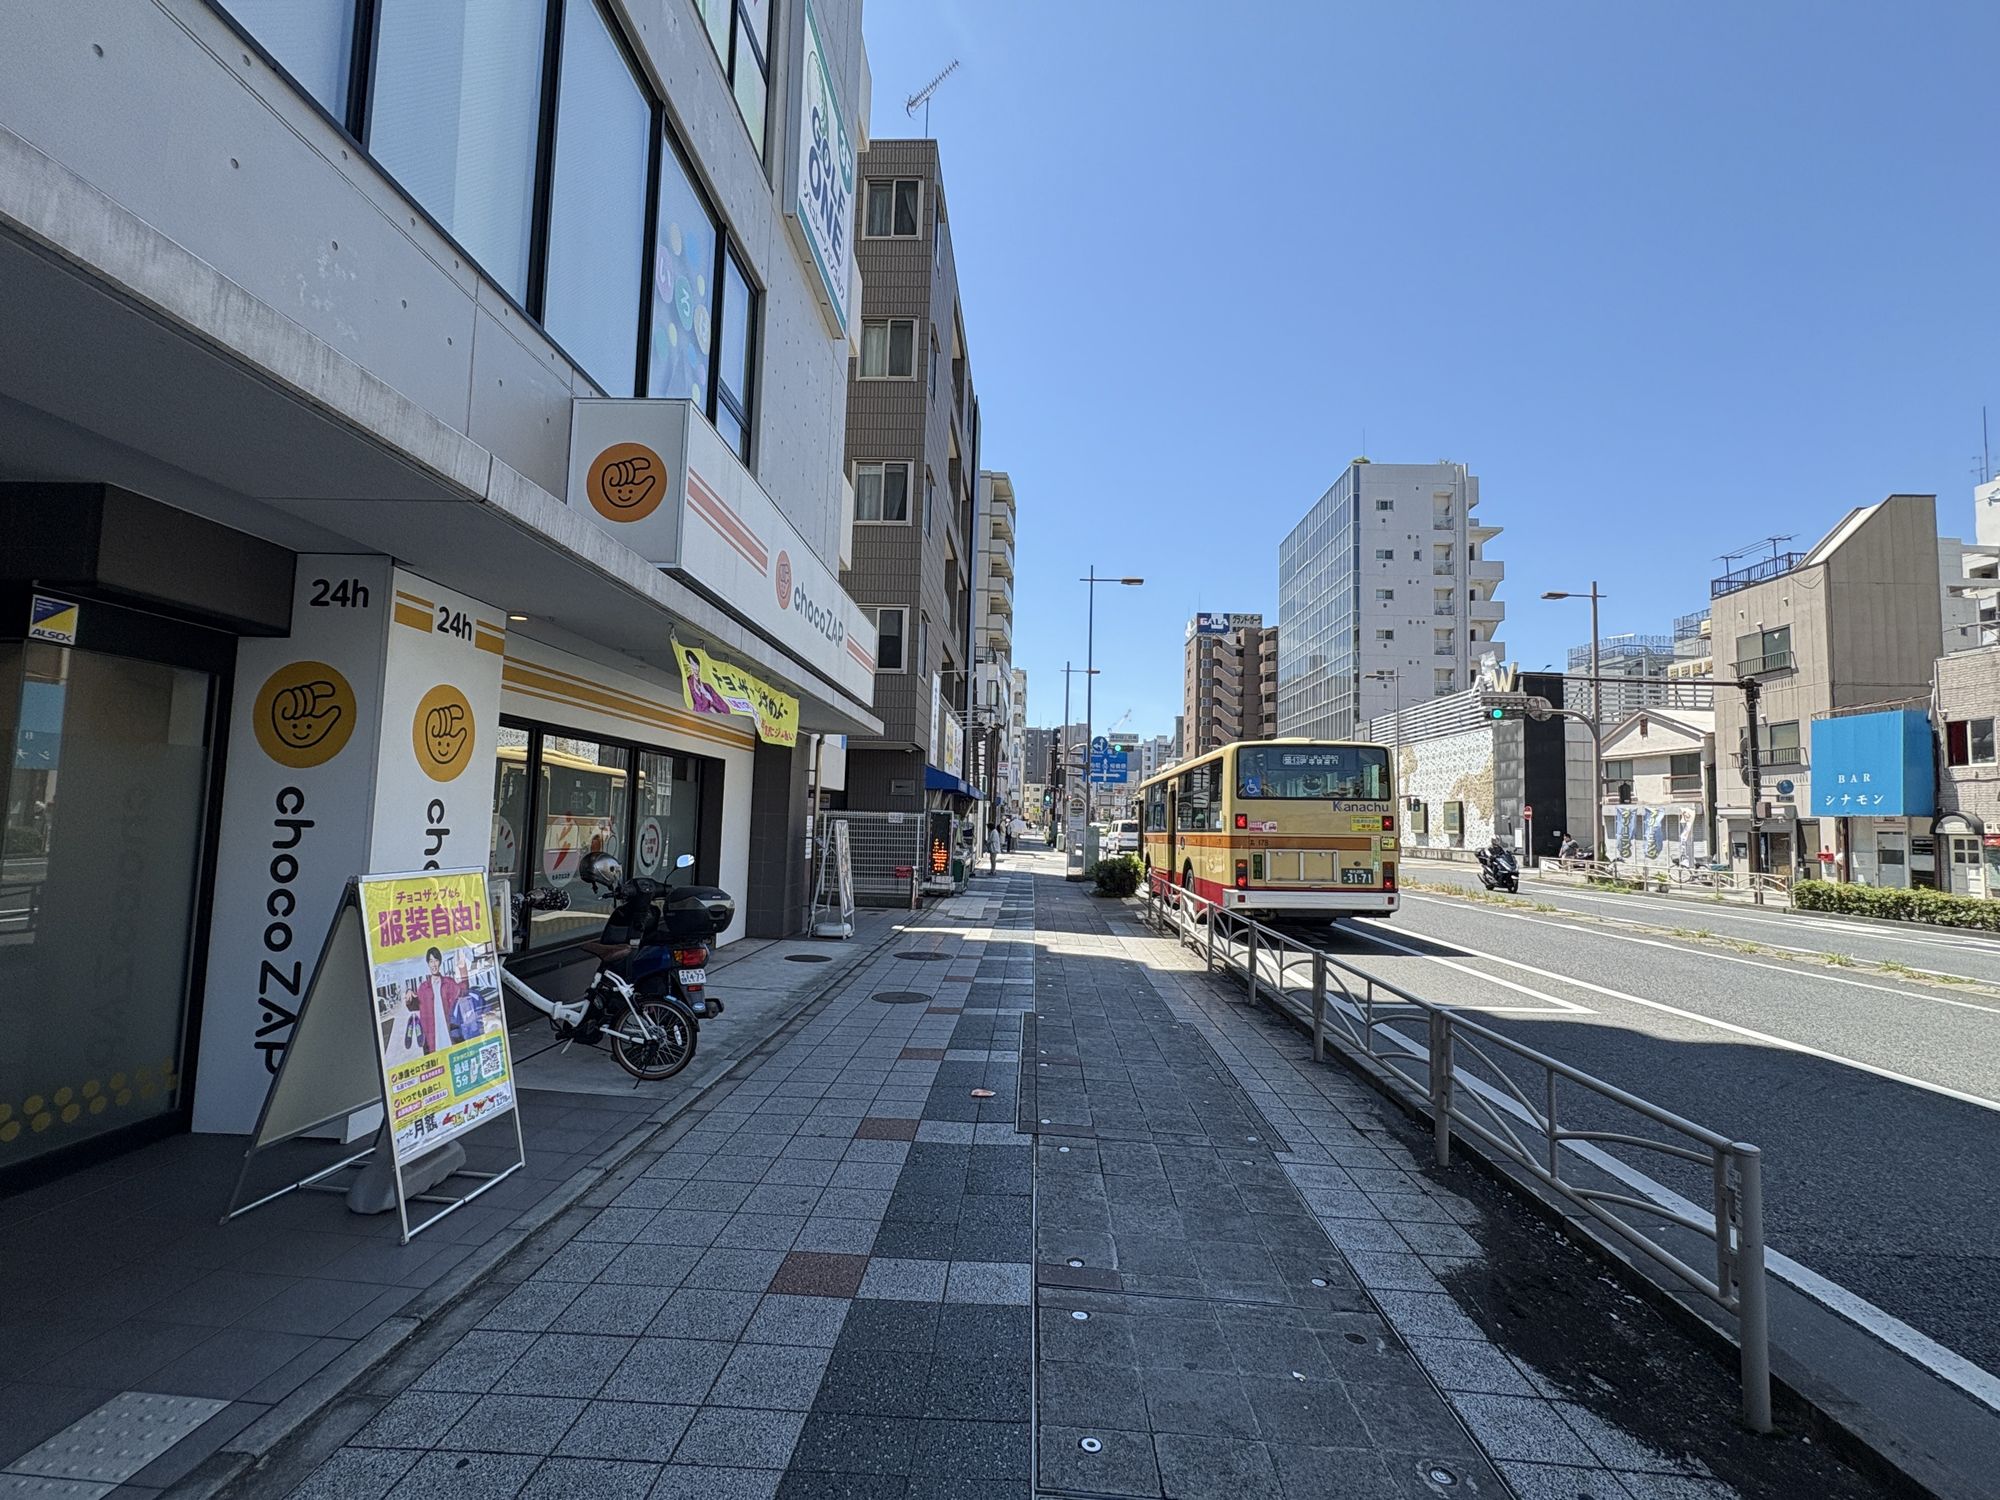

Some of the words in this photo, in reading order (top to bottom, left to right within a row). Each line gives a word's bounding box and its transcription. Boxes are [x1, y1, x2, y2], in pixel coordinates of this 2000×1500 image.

[811, 105, 847, 214] GOLF
[808, 145, 845, 266] ONE
[308, 578, 370, 609] 24h
[436, 606, 473, 643] 24h
[793, 581, 844, 647] chocoZAP
[1199, 617, 1229, 626] GALA
[31, 628, 73, 643] ALSOK
[1838, 773, 1872, 784] BAR
[1332, 800, 1390, 812] Kanachu
[1825, 793, 1885, 807] シナモン
[1347, 873, 1372, 884] 31-71
[395, 886, 461, 905] チョコザップなら
[254, 786, 315, 1075] chocoZAP
[378, 899, 482, 949] 服装自由!
[399, 1081, 442, 1105] いつでも自由に!
[455, 1075, 470, 1088] 5分
[414, 1112, 439, 1140] 月額
